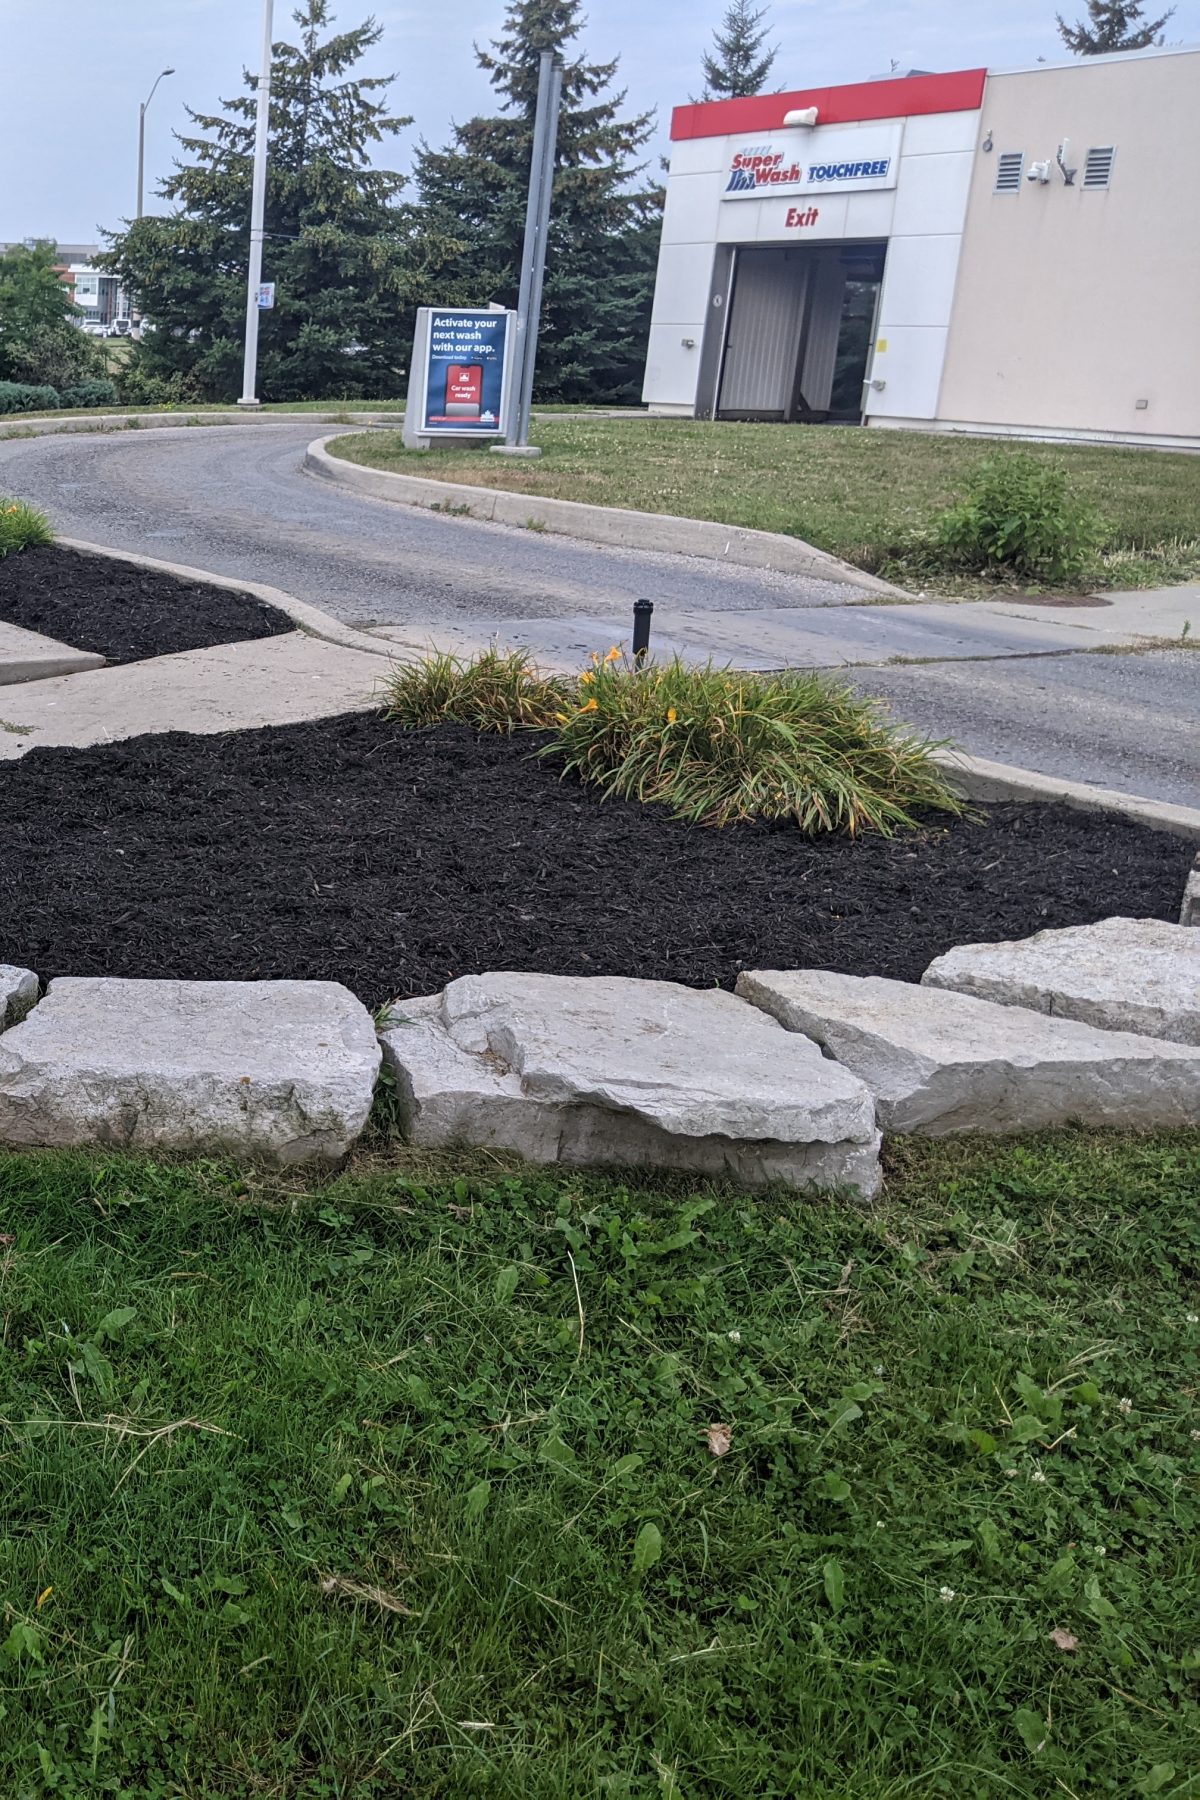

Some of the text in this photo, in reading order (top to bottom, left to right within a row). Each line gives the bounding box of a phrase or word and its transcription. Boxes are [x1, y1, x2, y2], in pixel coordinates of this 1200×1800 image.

[731, 153, 782, 171] Super
[808, 160, 888, 180] TOUCHFREE
[754, 163, 801, 184] Wash
[785, 207, 819, 228] Exit
[434, 318, 497, 330] Activate your
[433, 331, 481, 340] next wash
[432, 342, 453, 352] with
[473, 345, 495, 353] app.
